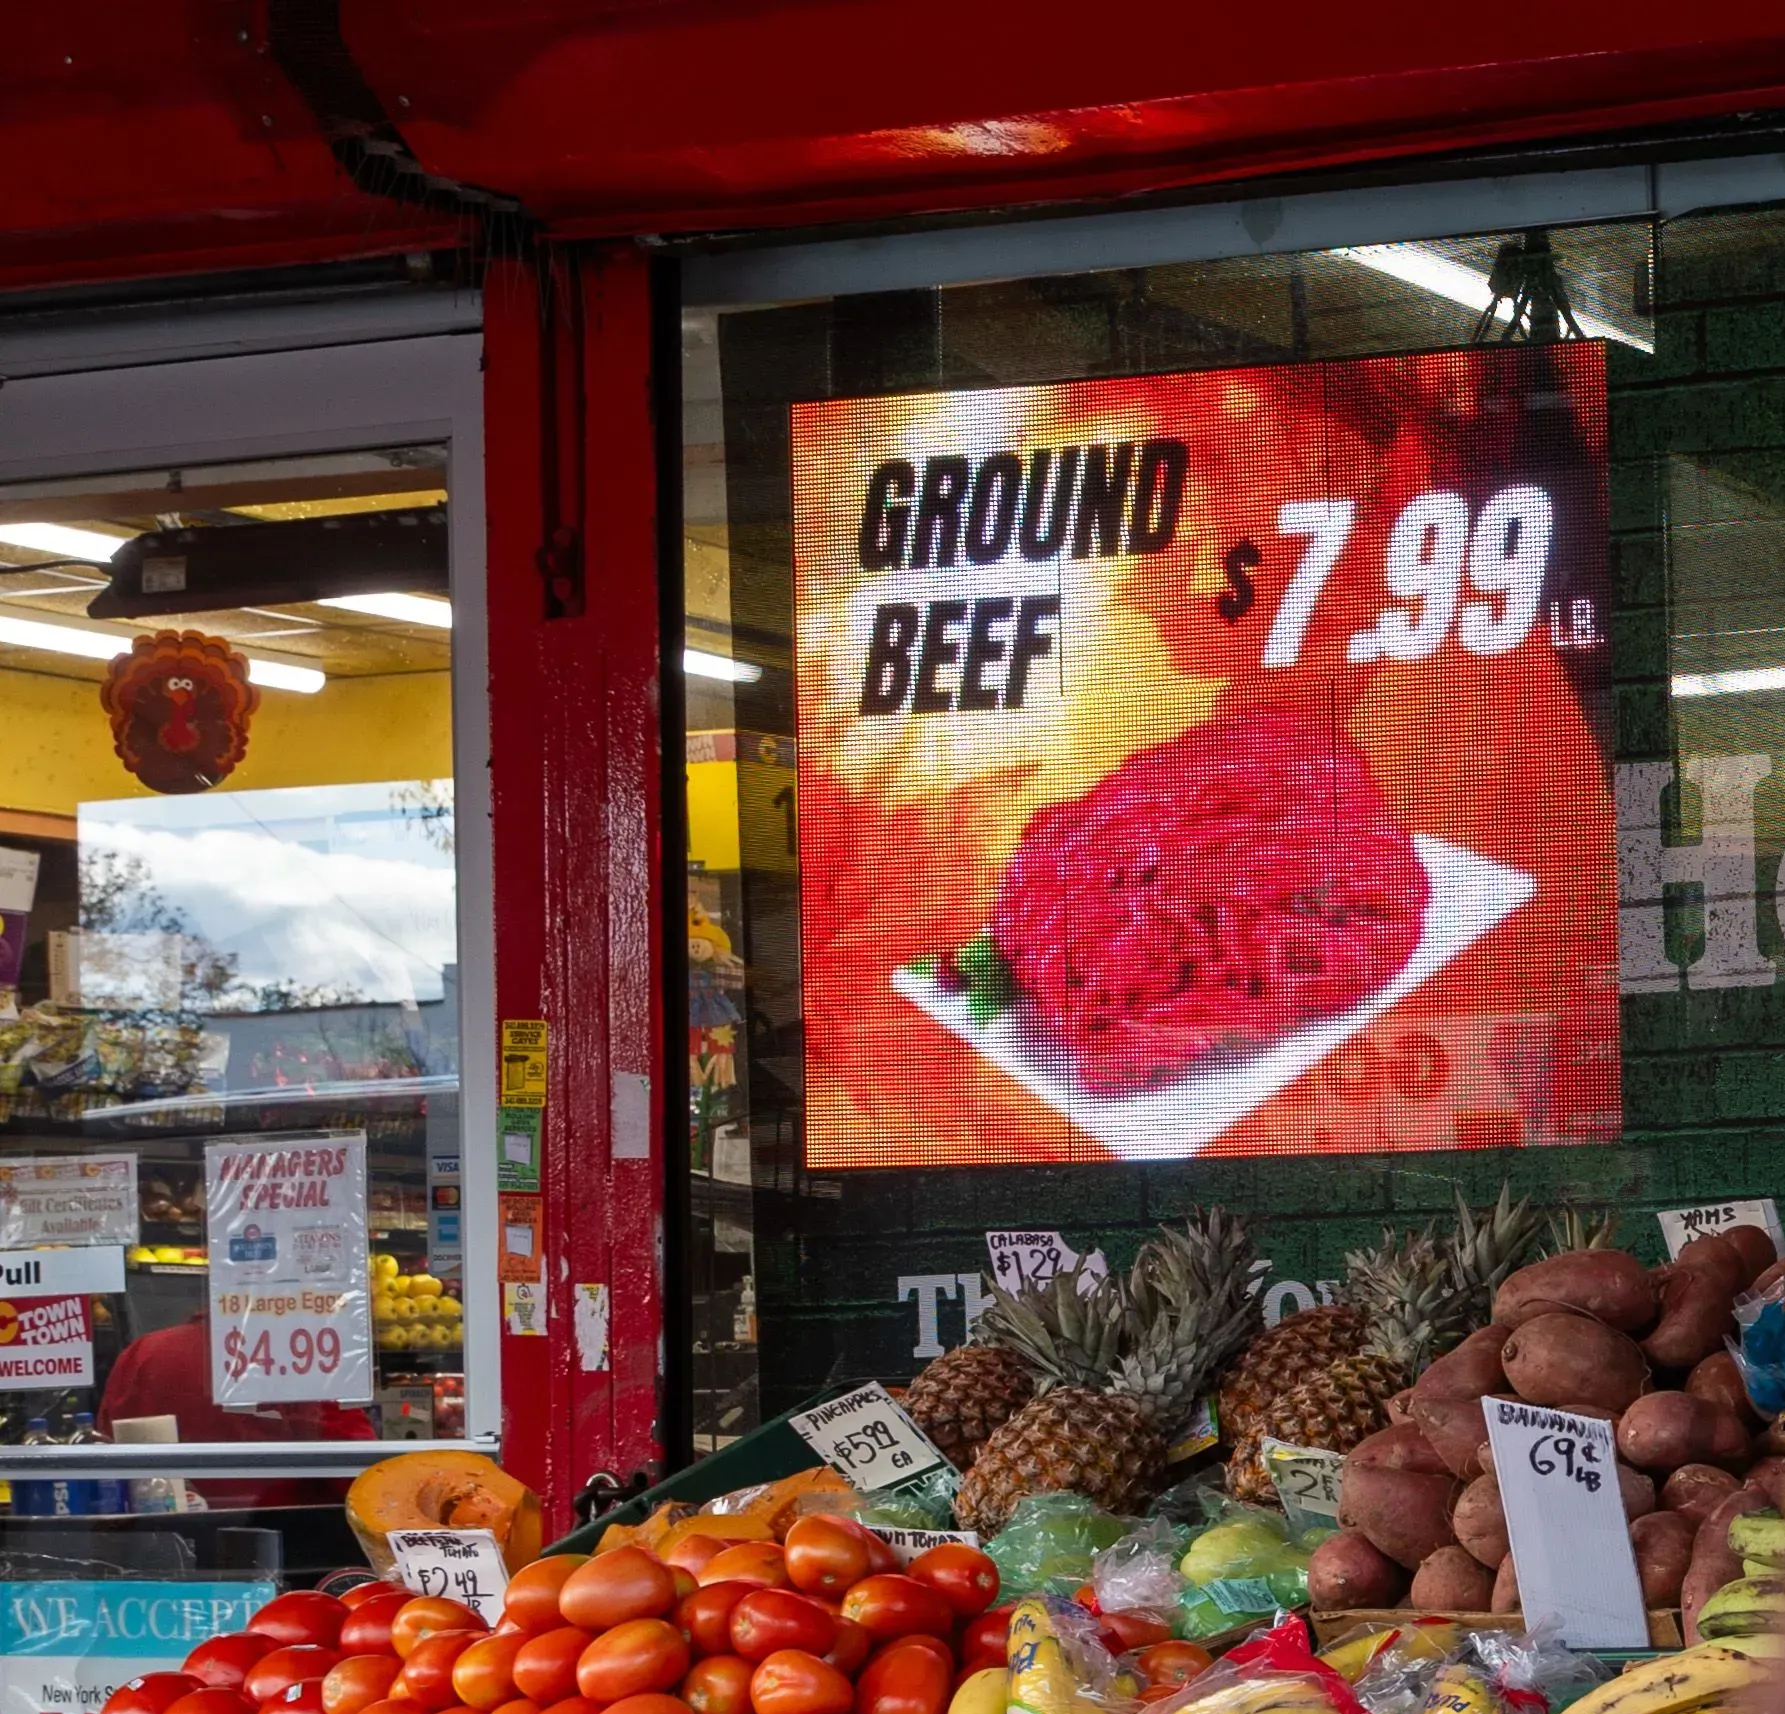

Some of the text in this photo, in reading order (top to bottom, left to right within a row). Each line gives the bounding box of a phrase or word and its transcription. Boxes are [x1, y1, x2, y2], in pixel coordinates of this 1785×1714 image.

[858, 438, 1191, 573] GROUND
[858, 594, 1061, 717] BEEF
[437, 1162, 460, 1173] VISA
[1680, 1207, 1737, 1230] YAMS
[18, 1297, 84, 1330] TOWN
[219, 1295, 239, 1315] 18
[0, 1356, 84, 1378] WELCOME
[224, 1326, 342, 1382] $4.99
[891, 1450, 913, 1468] EA
[53, 1481, 71, 1515] PSI
[13, 1597, 263, 1640] WE ACCEPT
[42, 1684, 101, 1704] New York
